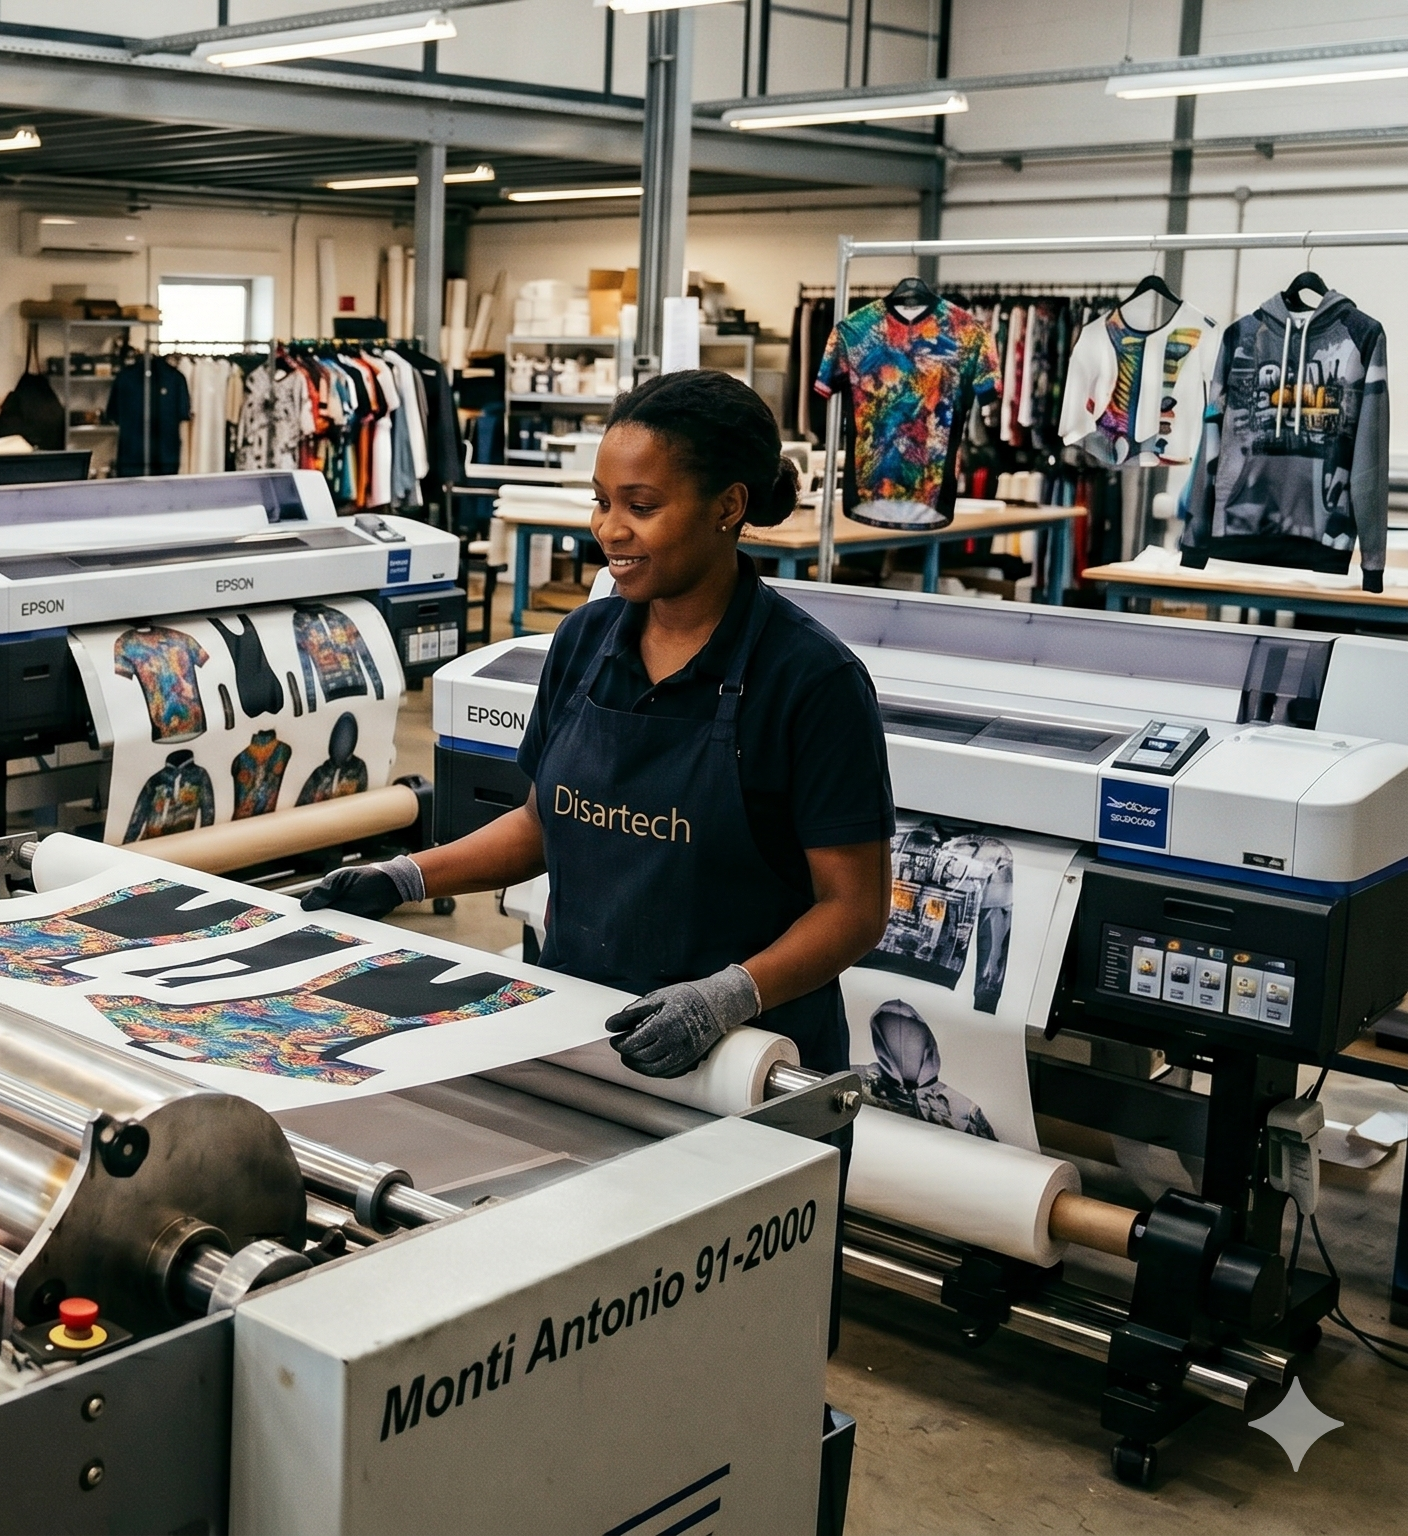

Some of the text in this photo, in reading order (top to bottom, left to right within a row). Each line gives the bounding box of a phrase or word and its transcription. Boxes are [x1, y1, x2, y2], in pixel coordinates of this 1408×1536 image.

[216, 577, 254, 593] EPSON
[21, 599, 64, 616] EPSON
[468, 705, 525, 731] EPSON
[554, 784, 691, 843] Disartech
[380, 1200, 817, 1442] Monti Antonio 91-2000
